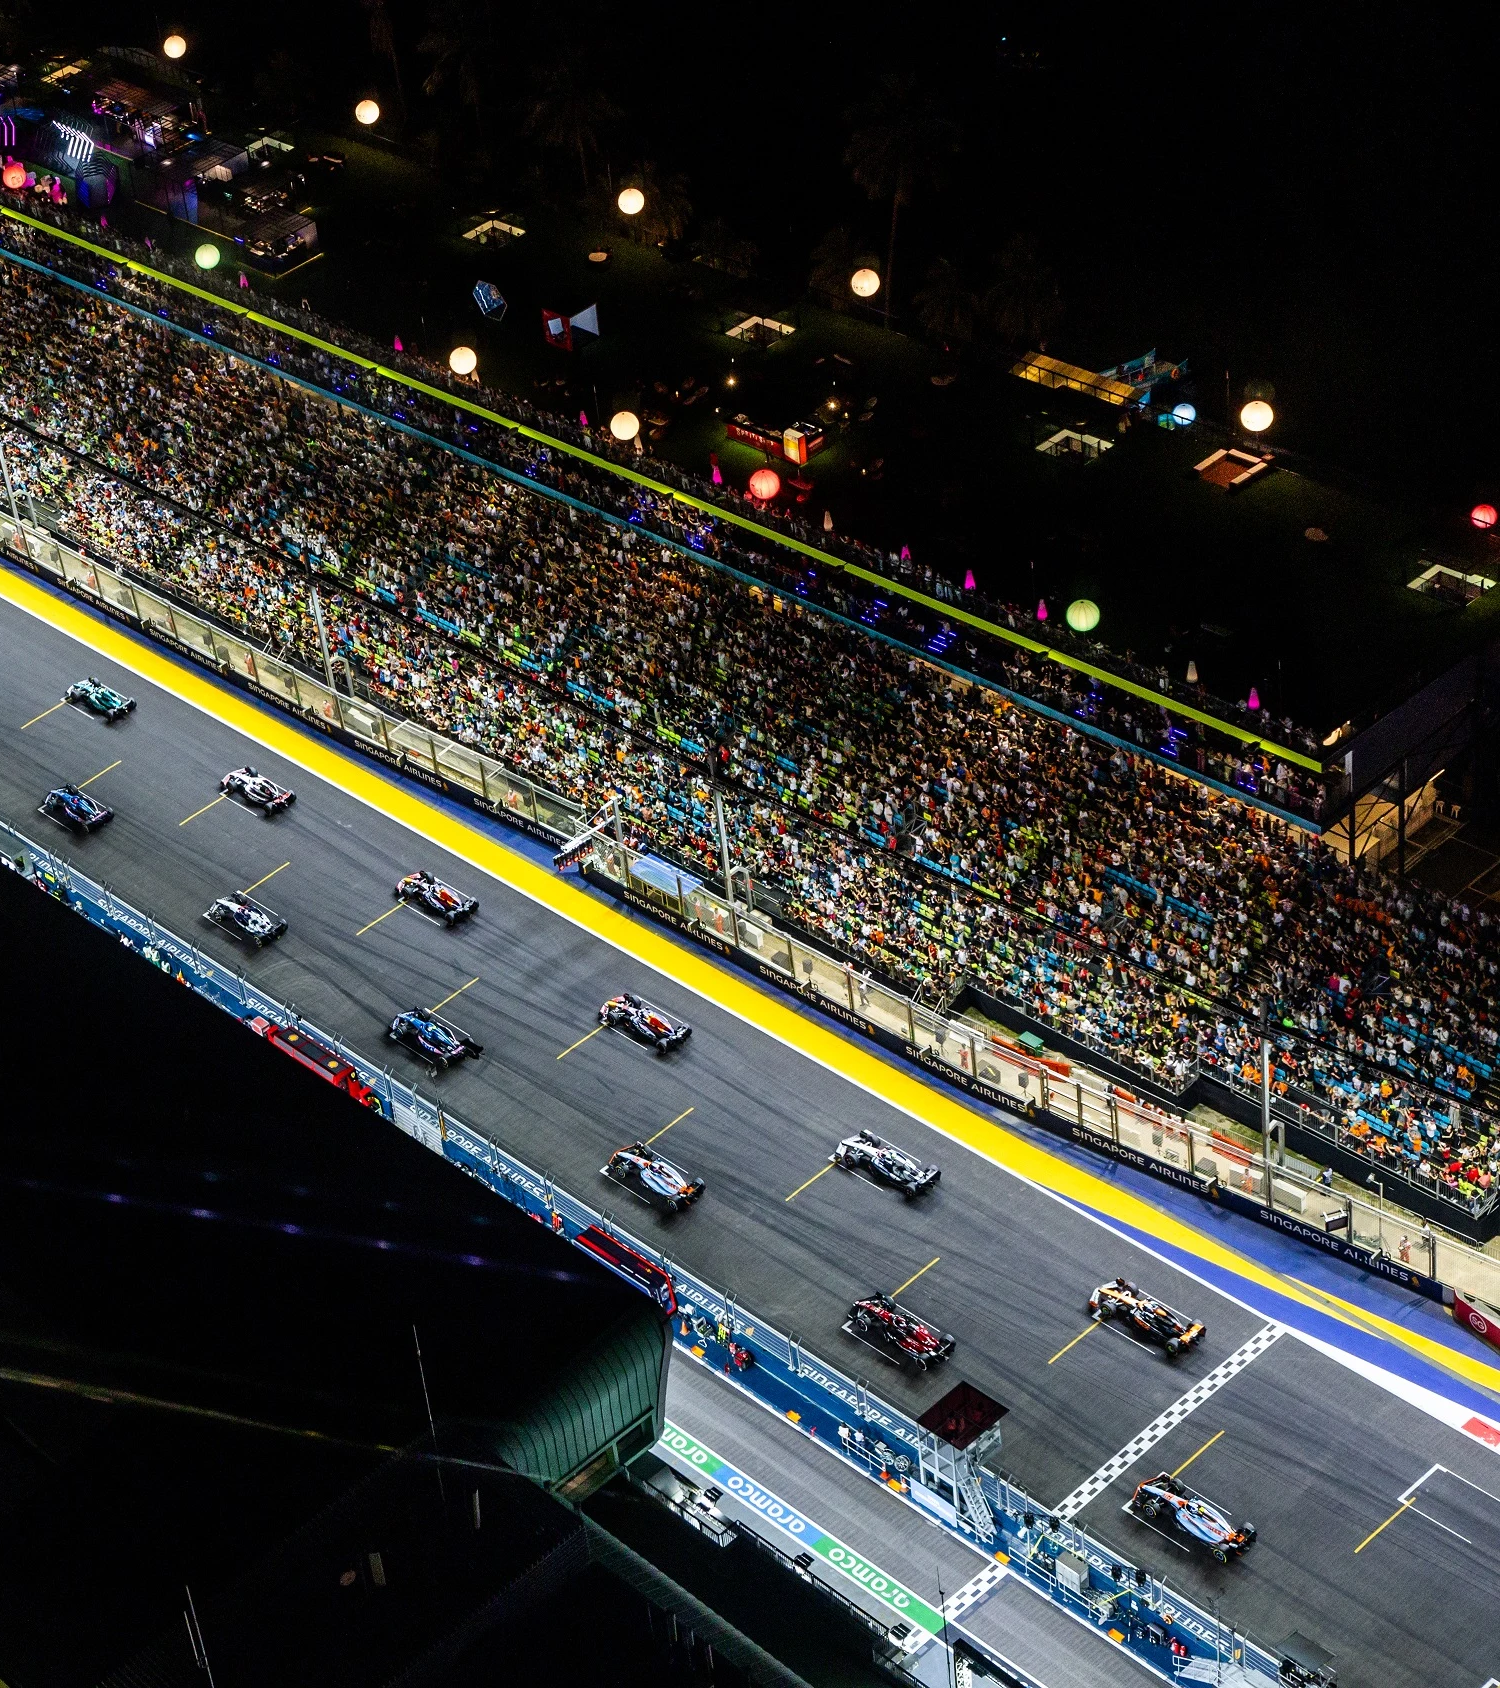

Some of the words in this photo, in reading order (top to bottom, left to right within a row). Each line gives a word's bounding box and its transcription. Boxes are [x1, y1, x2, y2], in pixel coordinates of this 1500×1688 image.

[95, 599, 127, 620] AIRLINES
[149, 628, 189, 655] SINGAPORE
[247, 681, 291, 711] SINGAPORE
[403, 763, 443, 789] AIRLINES
[623, 889, 678, 925] SINGAPORE
[819, 998, 867, 1031] AIRLINES
[970, 1081, 1026, 1114] AIRLINES
[1071, 1127, 1145, 1167] SINGAPORE
[1148, 1162, 1210, 1194] AIRLINES
[1259, 1209, 1340, 1252] SINGAPORE
[727, 1476, 806, 1534] aramco
[828, 1547, 911, 1608] aramco
